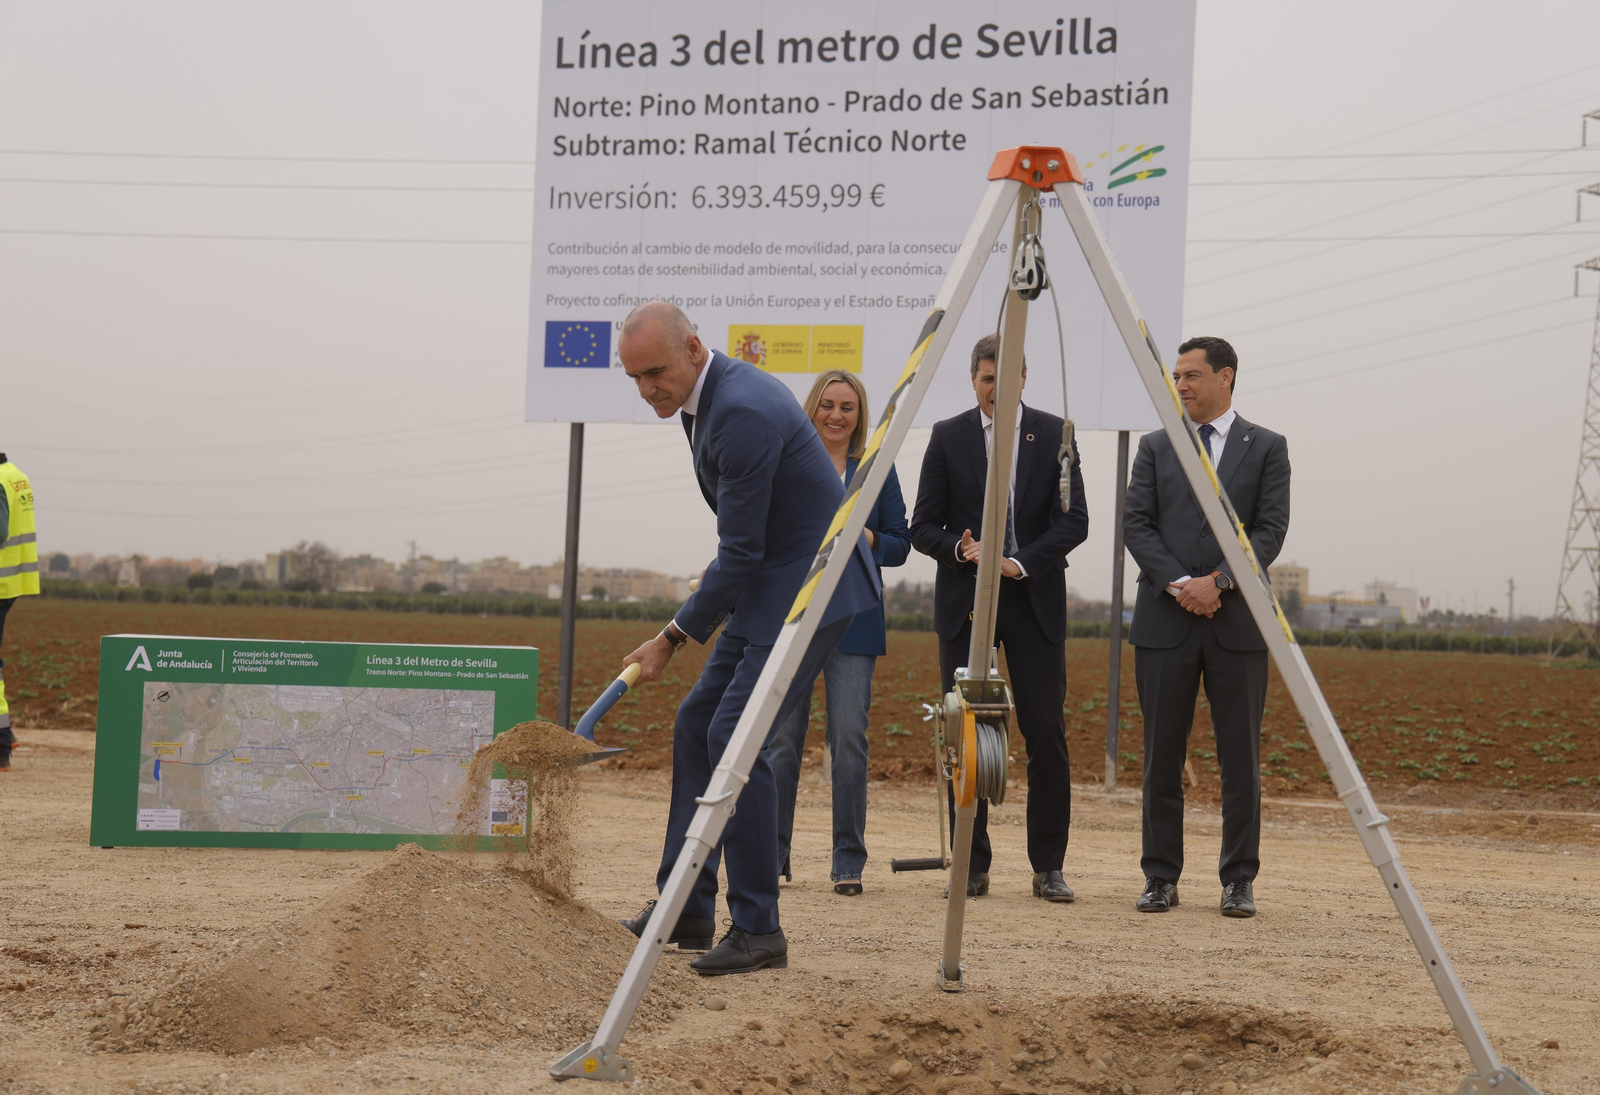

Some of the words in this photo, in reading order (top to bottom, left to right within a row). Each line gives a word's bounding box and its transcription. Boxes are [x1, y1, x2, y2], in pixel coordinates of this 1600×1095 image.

[555, 29, 658, 70] Línea
[669, 33, 691, 67] 3
[703, 29, 765, 67] del
[777, 29, 900, 64] metro
[912, 24, 963, 61] de
[976, 16, 1118, 59] Sevilla
[554, 96, 631, 117] Norte:
[641, 93, 697, 116] Pino
[705, 93, 819, 116] Montano
[845, 87, 923, 112] Prado
[931, 86, 963, 111] de
[972, 86, 1022, 110] San
[1031, 77, 1169, 109] Sebastián
[553, 134, 685, 157] Subtramo:
[695, 130, 776, 154] Ramal
[784, 126, 882, 153] Técnico
[892, 129, 967, 152] Norte
[549, 182, 677, 209] Inversión:
[691, 183, 862, 212] 6.393.459,99
[869, 183, 885, 208] €
[1093, 195, 1113, 207] con
[1117, 193, 1160, 210] Europa
[548, 242, 628, 255] Contribución
[631, 242, 643, 255] al
[645, 242, 692, 255] cambio
[695, 242, 710, 255] de
[717, 242, 763, 255] modelo
[766, 242, 782, 255] de
[785, 242, 853, 257] movilidad,
[857, 245, 886, 258] para
[890, 242, 900, 255] la
[904, 244, 961, 254] consecu
[990, 241, 1007, 254] de
[547, 266, 600, 279] mayores
[603, 264, 636, 276] cotas
[638, 263, 654, 276] de
[657, 263, 745, 276] sostenibilidad
[748, 263, 817, 278] ambiental,
[820, 263, 858, 276] social
[861, 266, 869, 279] y
[871, 262, 947, 276] económica.
[546, 294, 600, 310] Proyecto
[686, 297, 708, 310] por
[711, 294, 723, 308] la
[726, 294, 764, 308] Unión
[768, 294, 821, 311] Europea
[824, 298, 832, 310] y
[834, 294, 846, 308] el
[849, 294, 891, 308] Estado
[896, 294, 936, 310] Españ
[157, 650, 182, 658] Junta
[232, 657, 273, 665] Articulación
[275, 657, 286, 665] del
[287, 658, 318, 667] Territorio
[233, 650, 268, 660] Consejería
[280, 651, 313, 659] Formento
[366, 655, 393, 665] Línea
[395, 656, 401, 665] 3
[403, 656, 419, 666] del
[421, 657, 449, 667] Metro
[451, 657, 464, 667] de
[465, 658, 497, 668] Sevilla
[157, 659, 168, 668] de
[169, 659, 213, 669] Andalucía
[238, 665, 267, 673] Vivienda
[387, 669, 407, 677] Norte:
[424, 670, 452, 678] Montano
[457, 671, 475, 679] Prado
[476, 671, 484, 679] de
[498, 672, 529, 680] Sebastián
